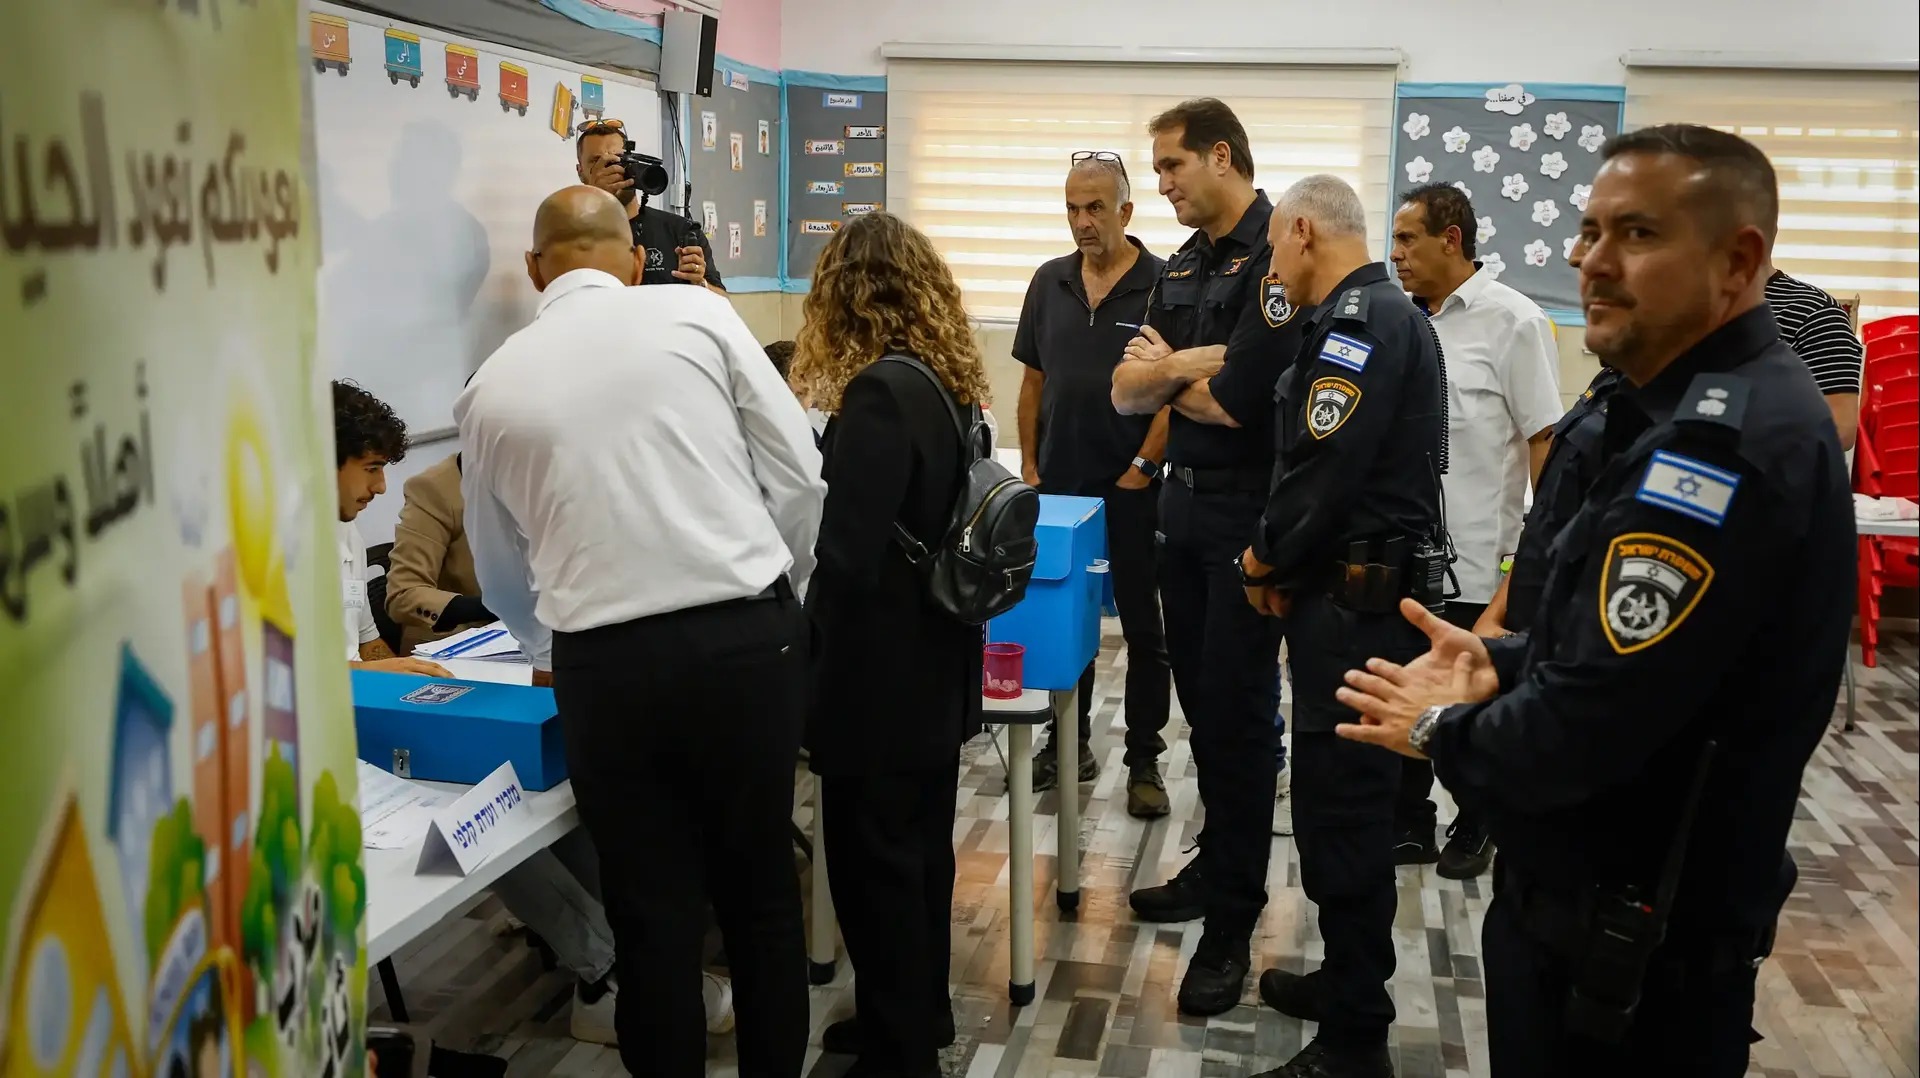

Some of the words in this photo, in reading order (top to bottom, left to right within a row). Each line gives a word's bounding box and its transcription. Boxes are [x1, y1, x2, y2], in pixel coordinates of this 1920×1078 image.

[322, 31, 336, 48] من
[396, 42, 410, 63] إلى
[457, 56, 468, 79] في
[1518, 93, 1526, 106] في
[856, 128, 873, 137] الأحد
[1315, 382, 1334, 391] ישראל
[1333, 382, 1356, 397] משטרת
[1618, 543, 1660, 557] ישראל
[1656, 547, 1704, 580] משטרת
[495, 783, 521, 814] מזכיר
[474, 801, 499, 834] ועדת
[452, 819, 479, 849] קלפי
